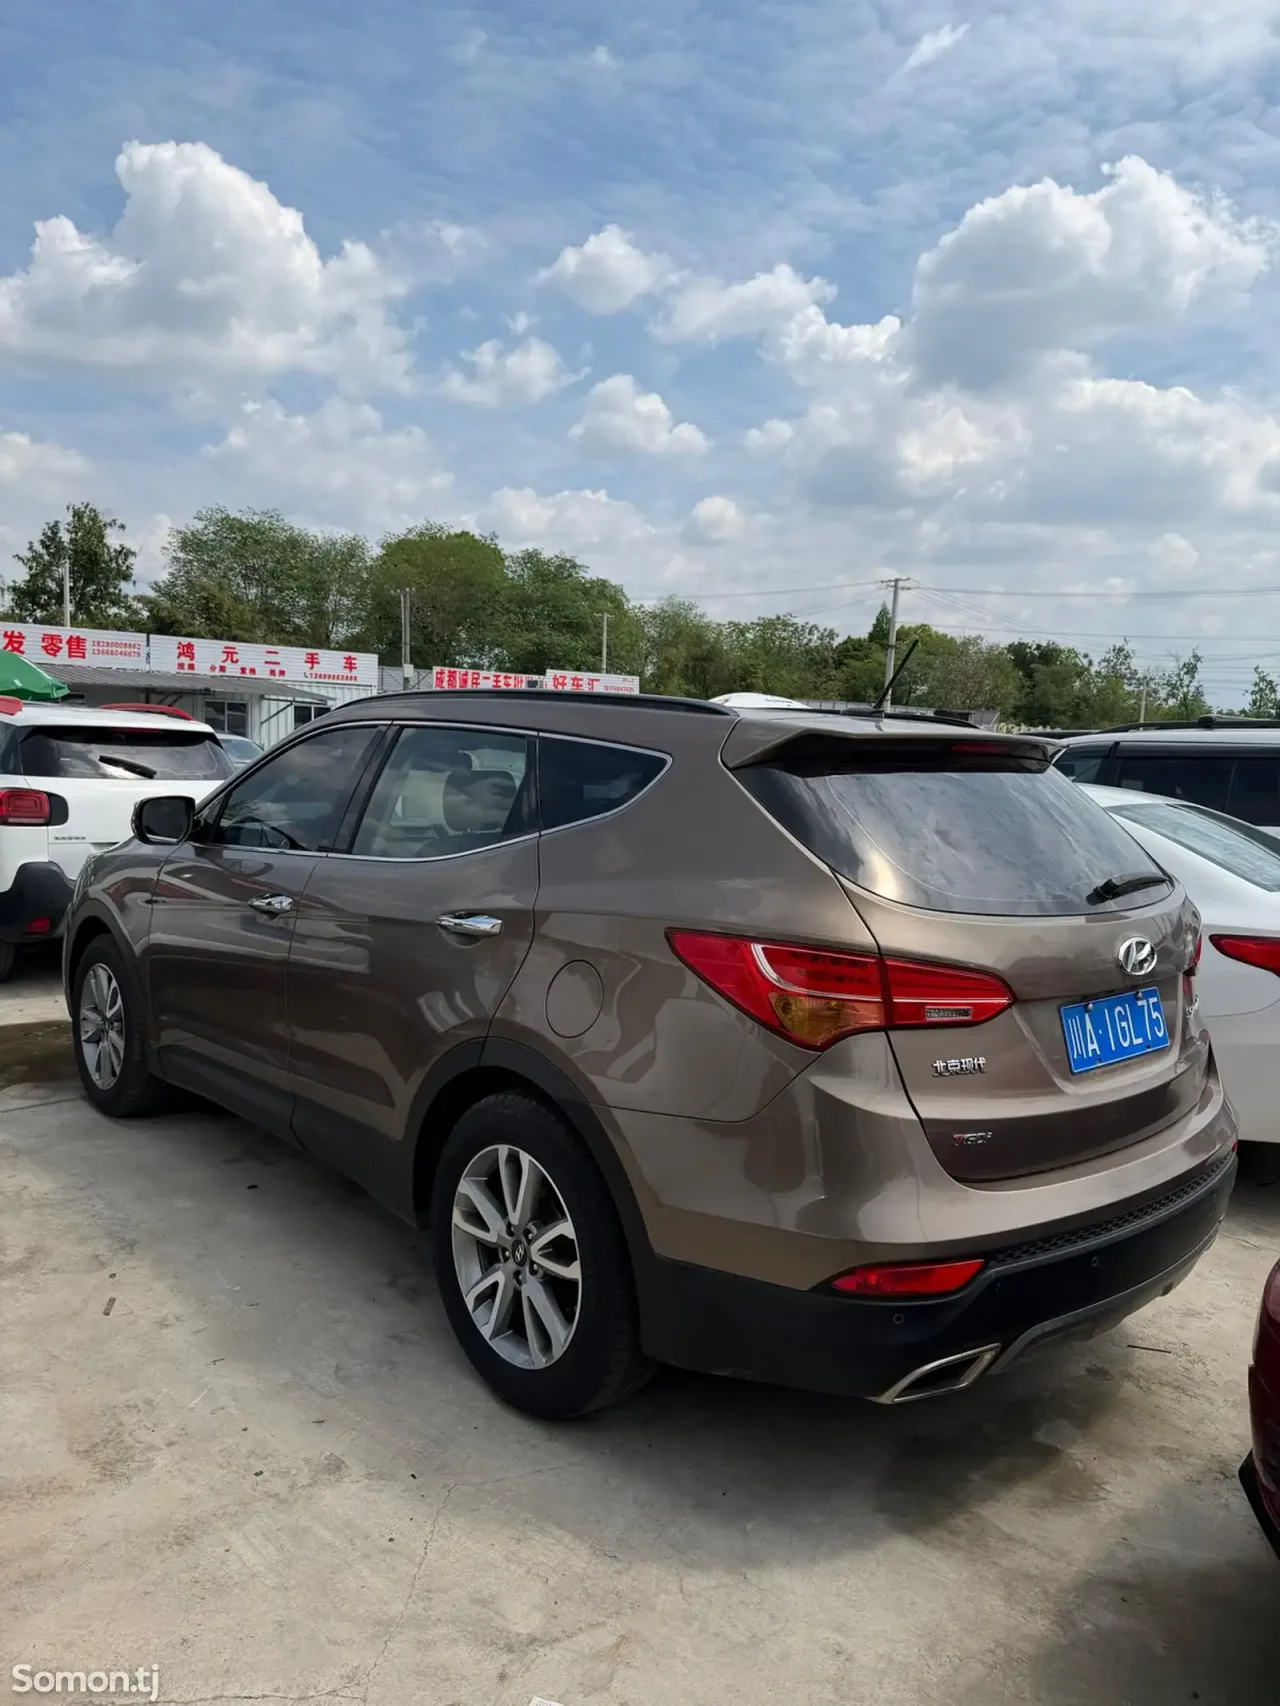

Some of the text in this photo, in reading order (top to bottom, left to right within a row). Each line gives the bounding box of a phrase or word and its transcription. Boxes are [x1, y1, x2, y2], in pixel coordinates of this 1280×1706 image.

[2, 630, 87, 659] 发 零售
[177, 641, 358, 673] 鸿元二手车
[933, 1057, 987, 1076] 北京现代
